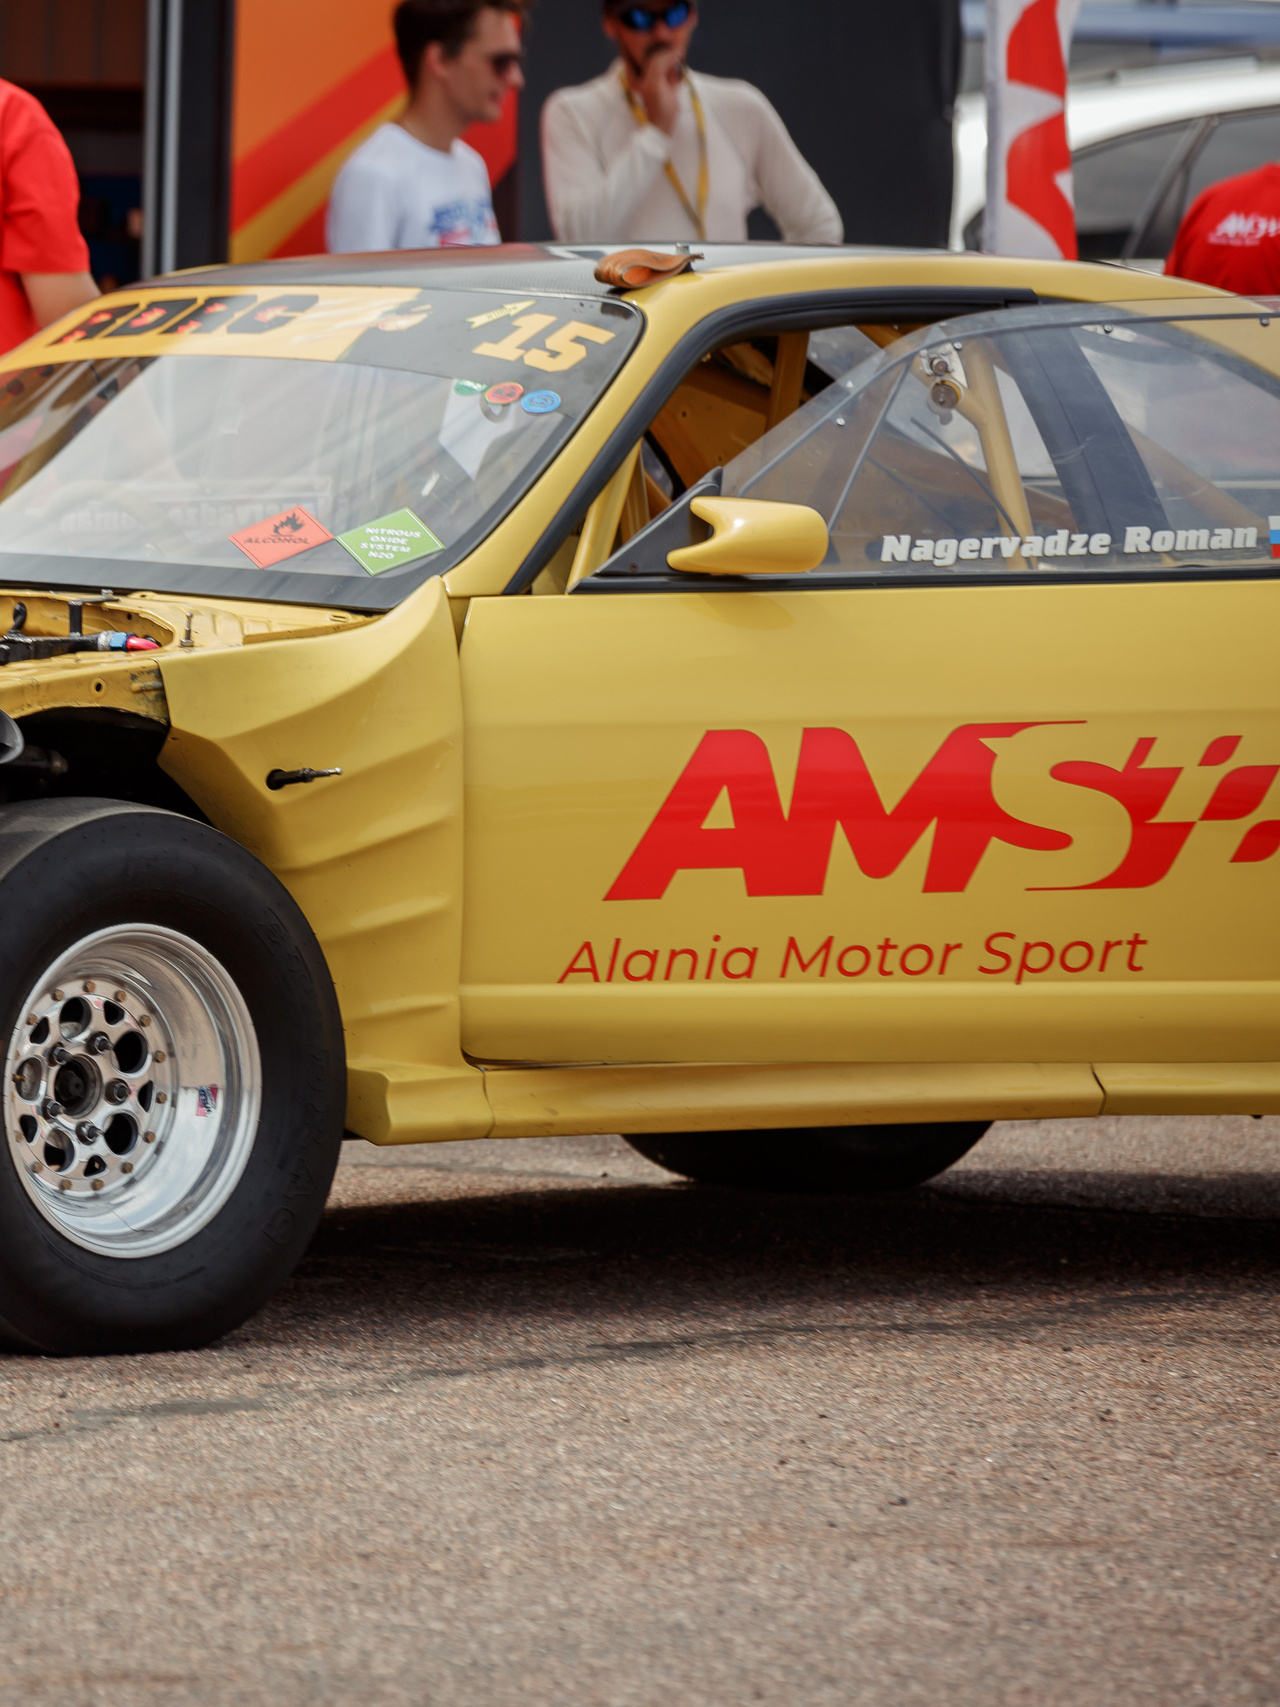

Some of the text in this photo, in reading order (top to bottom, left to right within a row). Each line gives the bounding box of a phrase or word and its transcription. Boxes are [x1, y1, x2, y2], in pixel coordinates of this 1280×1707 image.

[471, 312, 617, 373] 15
[364, 526, 421, 539] NITROUS
[369, 535, 408, 545] OXIDE
[880, 525, 1258, 567] Nagervadze Roman
[359, 542, 411, 554] SYSTEM
[557, 931, 1149, 986] Alania Motor Sport
